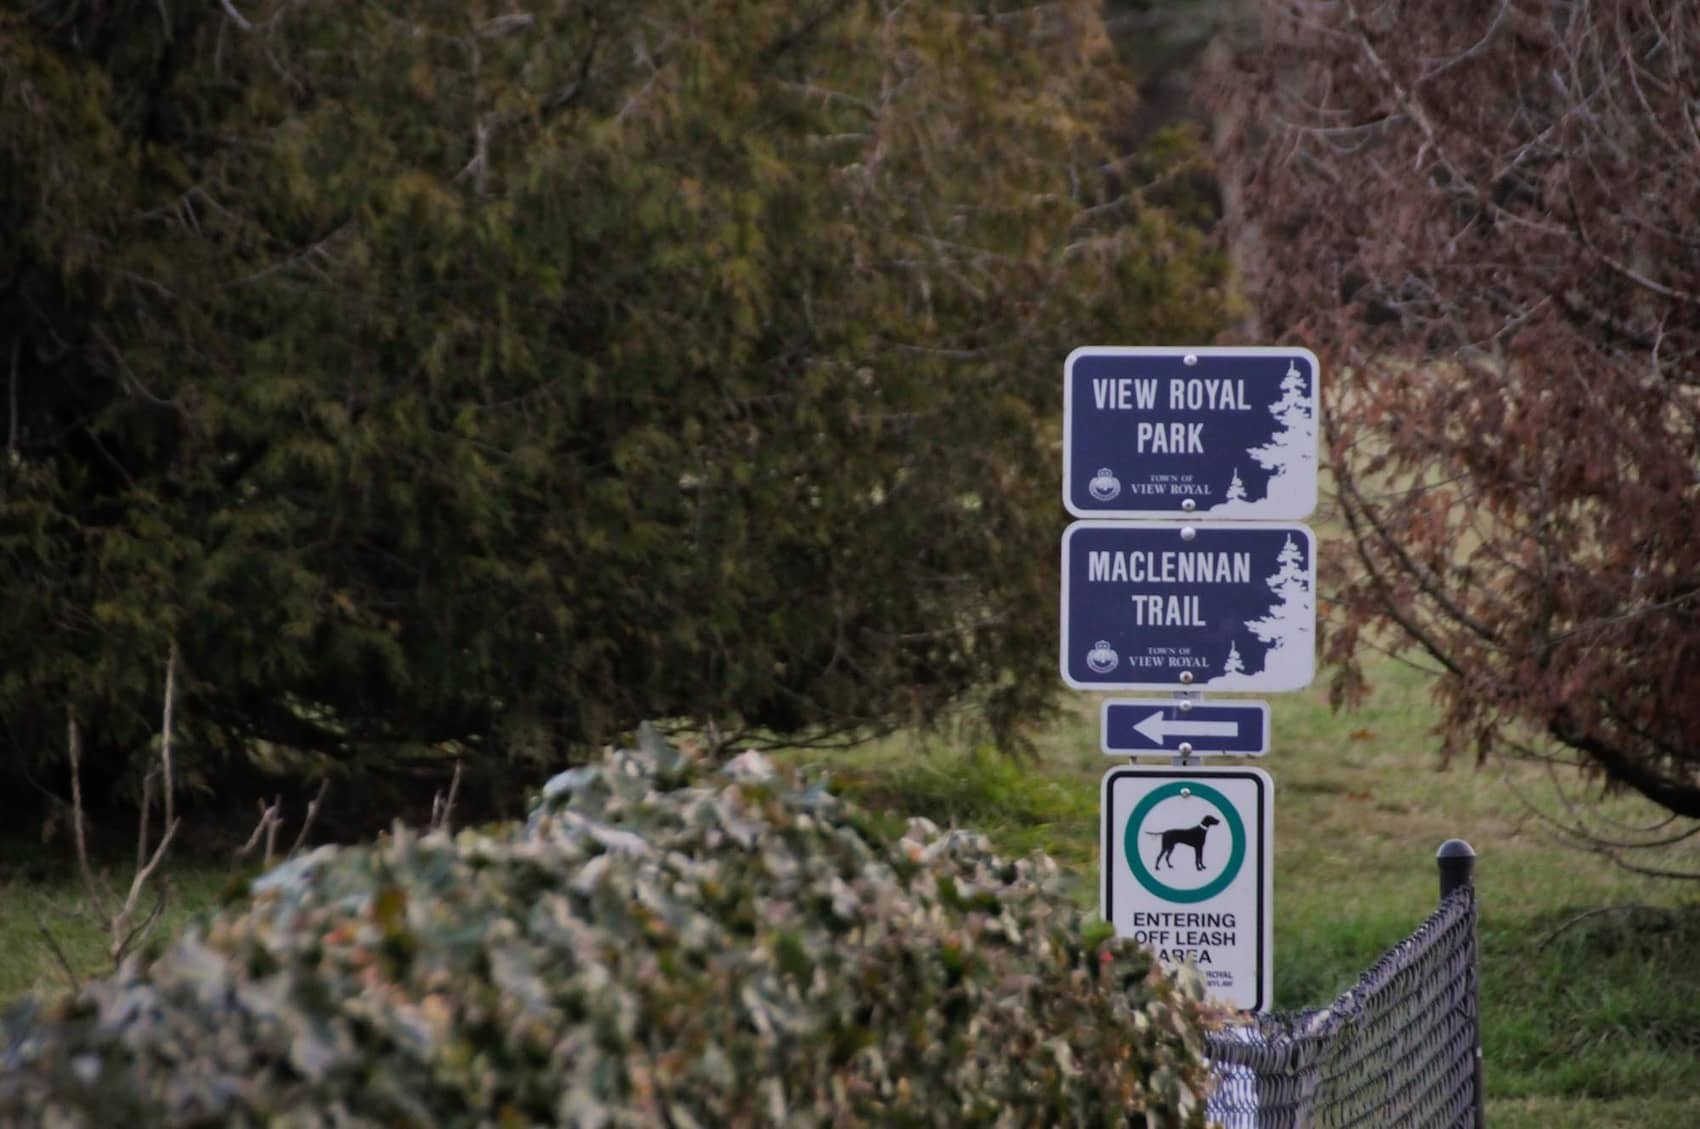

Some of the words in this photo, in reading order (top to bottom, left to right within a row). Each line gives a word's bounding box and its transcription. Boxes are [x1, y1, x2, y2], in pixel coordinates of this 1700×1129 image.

[1092, 378, 1158, 410] VIEW
[1170, 379, 1251, 411] ROYAL
[1137, 422, 1204, 454] PARK
[1150, 474, 1178, 482] TOWN
[1181, 474, 1193, 482] OF
[1131, 483, 1168, 495] VIEW
[1171, 484, 1212, 496] ROYAL
[1088, 551, 1250, 583] MACLENNAN
[1131, 595, 1206, 626] TRAIL
[1148, 647, 1176, 655] TOWN
[1179, 647, 1191, 655] OF
[1129, 656, 1165, 667] VIEW
[1169, 656, 1210, 668] ROYAL
[1133, 912, 1236, 928] ENTERING
[1134, 930, 1169, 945] OFF
[1175, 931, 1236, 946] LEASH
